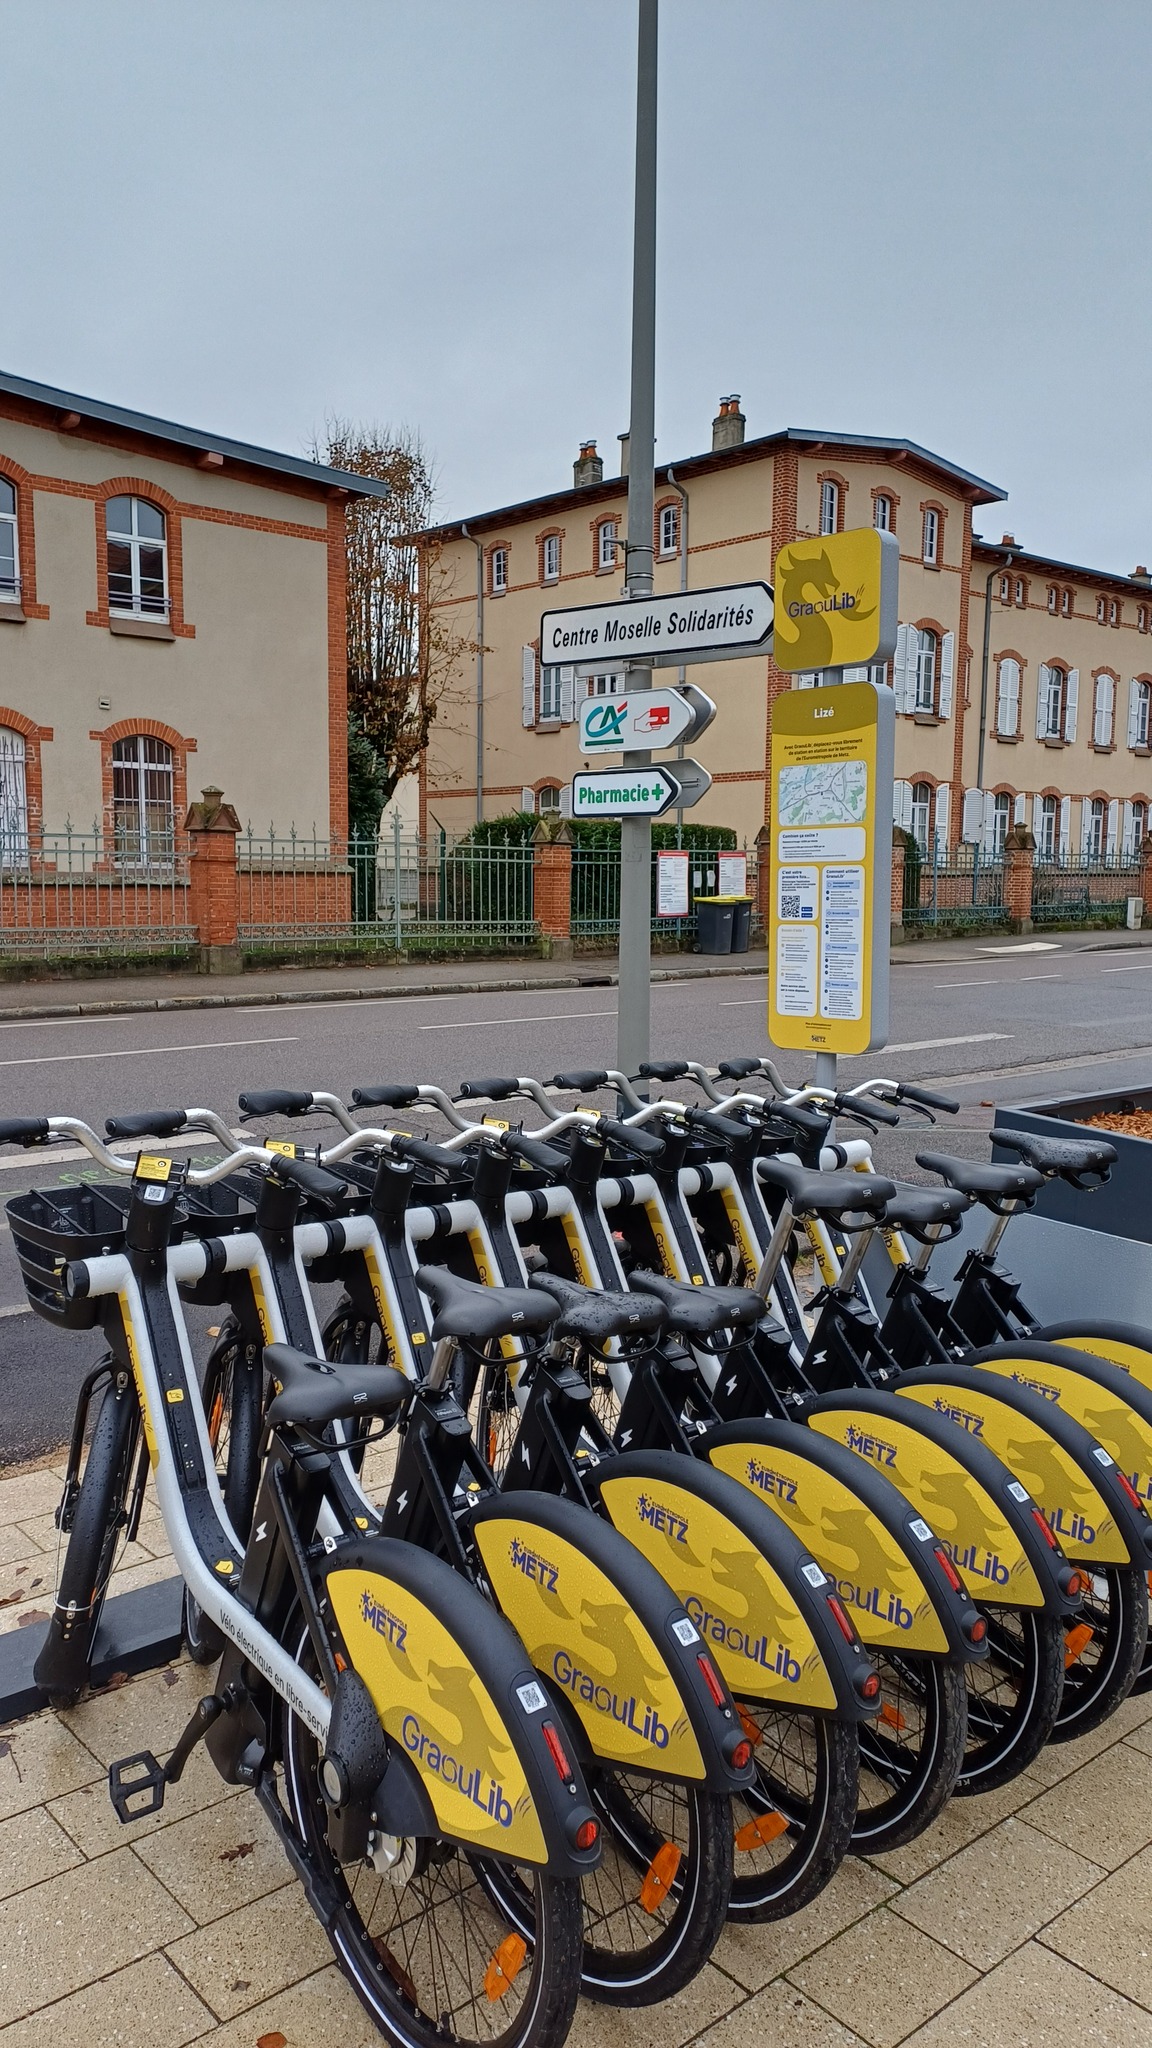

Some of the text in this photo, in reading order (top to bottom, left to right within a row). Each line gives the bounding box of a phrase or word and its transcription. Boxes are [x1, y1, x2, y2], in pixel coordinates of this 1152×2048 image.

[553, 604, 754, 648] Centre Moselle Solidarités
[788, 592, 855, 618] GraouLib
[814, 706, 834, 720] Lizé
[579, 785, 650, 804] Pharmacie
[850, 1436, 897, 1468] METZ
[750, 1470, 797, 1504] METZ
[641, 1506, 688, 1544] METZ
[513, 1550, 558, 1594] METZ
[364, 1604, 407, 1653] METZ
[685, 1597, 801, 1683] GraouLib
[220, 1609, 329, 1738] Vélo électrique en libre-servi
[553, 1651, 669, 1749] GraouLib
[402, 1714, 513, 1828] GraouLib
